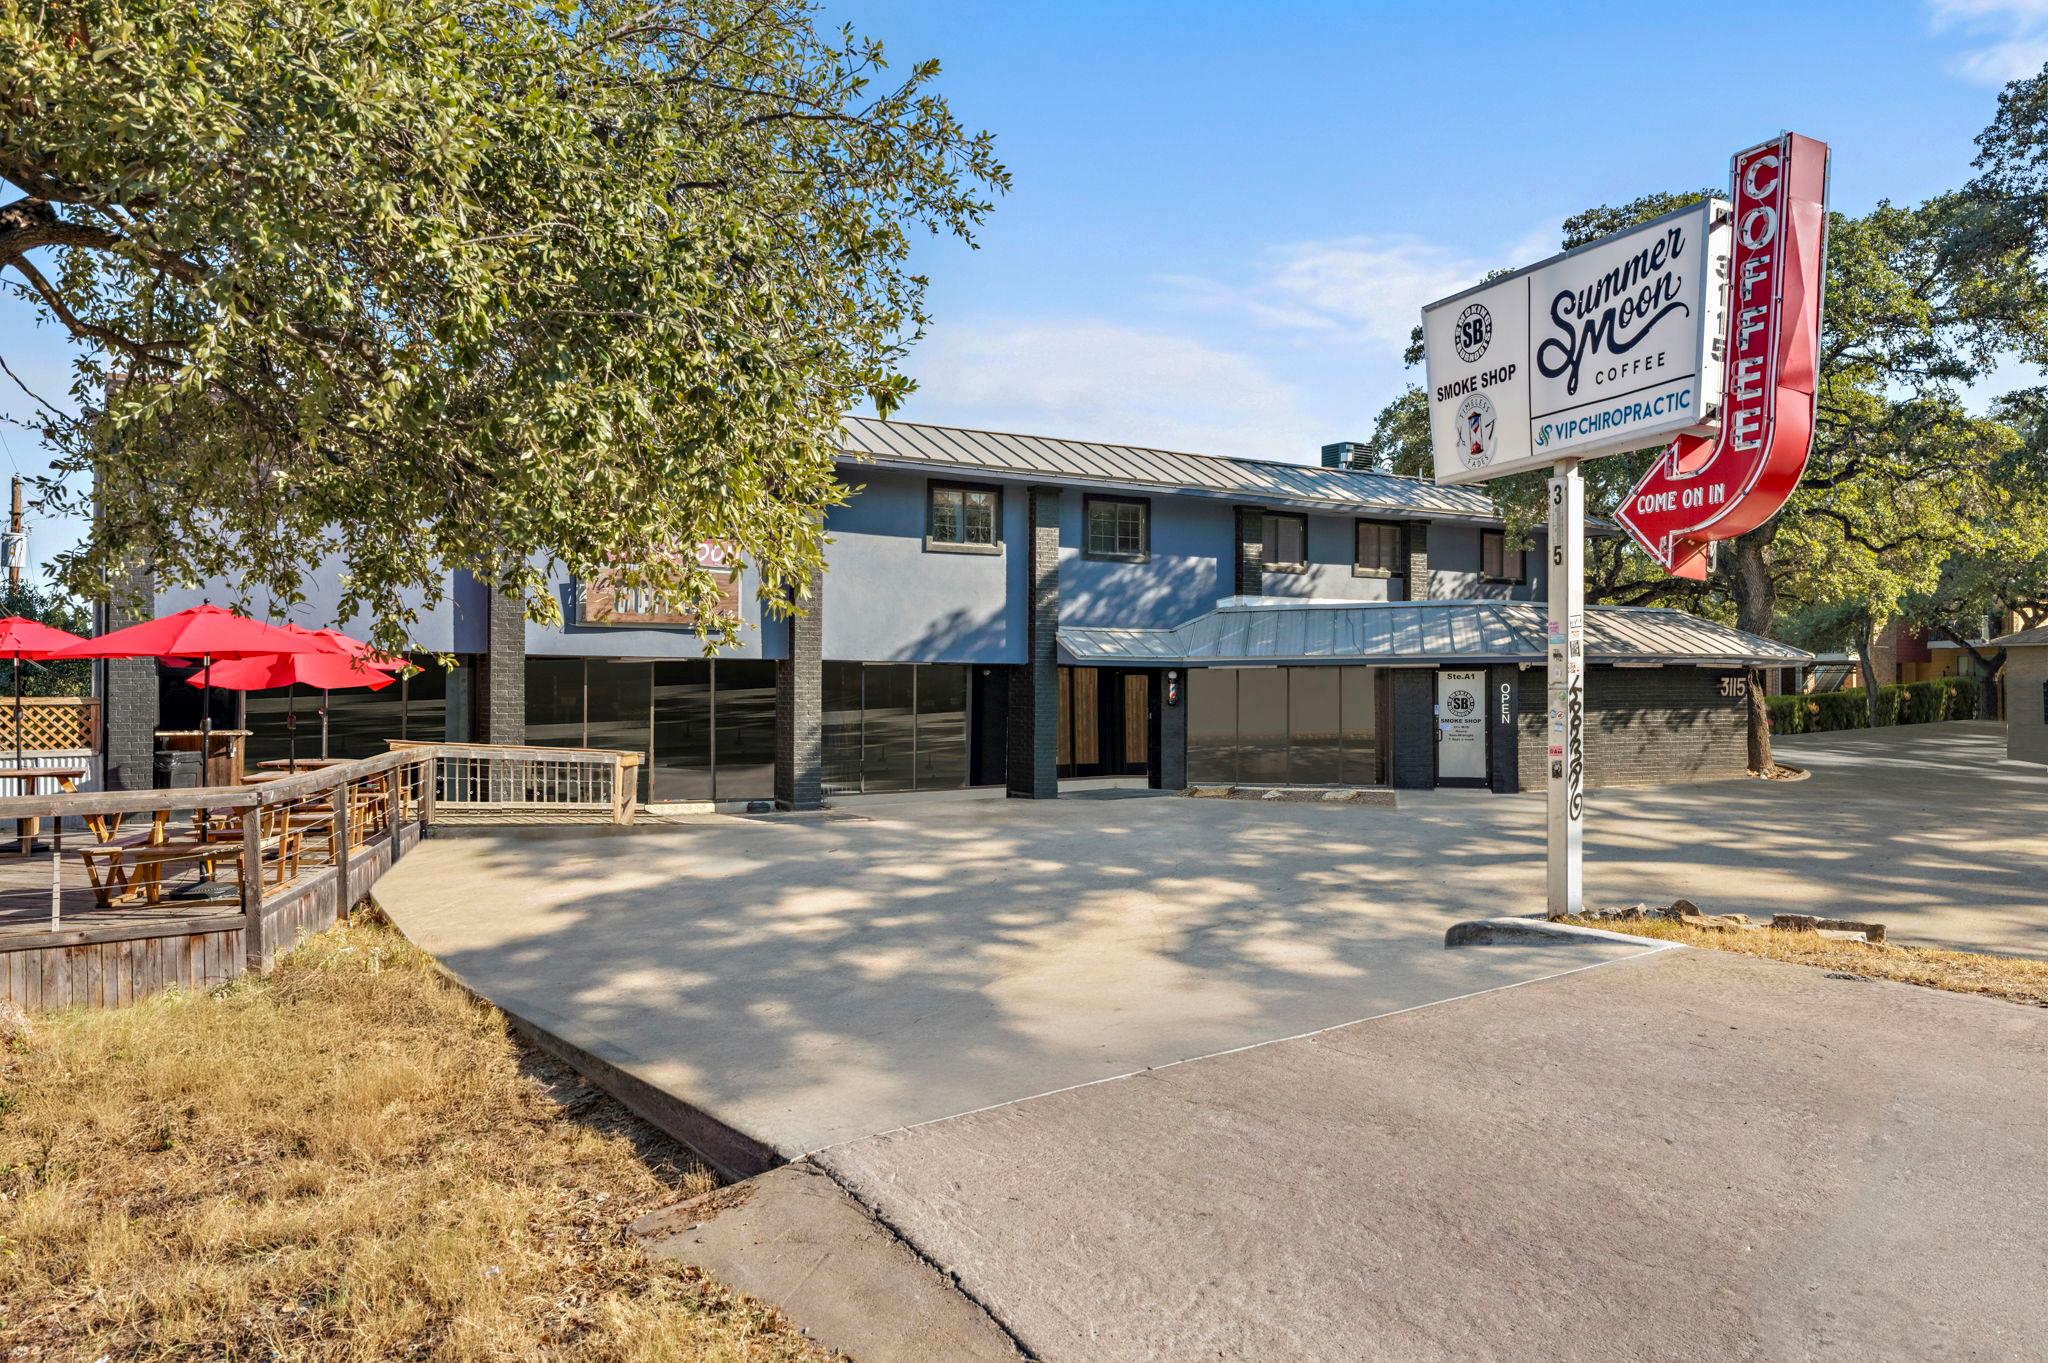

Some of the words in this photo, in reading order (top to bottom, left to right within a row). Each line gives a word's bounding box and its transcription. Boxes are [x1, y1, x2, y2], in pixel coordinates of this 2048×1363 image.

[1537, 227, 1686, 379] Summer
[1711, 255, 1729, 362] 3115
[1731, 154, 1778, 451] COFFEE
[1456, 304, 1492, 336] SMOKING
[1462, 317, 1484, 349] SB
[1567, 271, 1690, 396] Moon
[1437, 376, 1478, 403] SMOKE
[1481, 363, 1517, 388] SHOP
[1595, 352, 1666, 385] COFFEE
[1459, 398, 1491, 419] TIMELESS
[1467, 455, 1490, 468] FADES
[1637, 490, 1678, 515] COME
[1682, 486, 1704, 509] ON
[1708, 483, 1726, 505] IN
[1720, 677, 1746, 697] 3115
[1453, 697, 1469, 710] SB
[1501, 683, 1511, 724] OPEN
